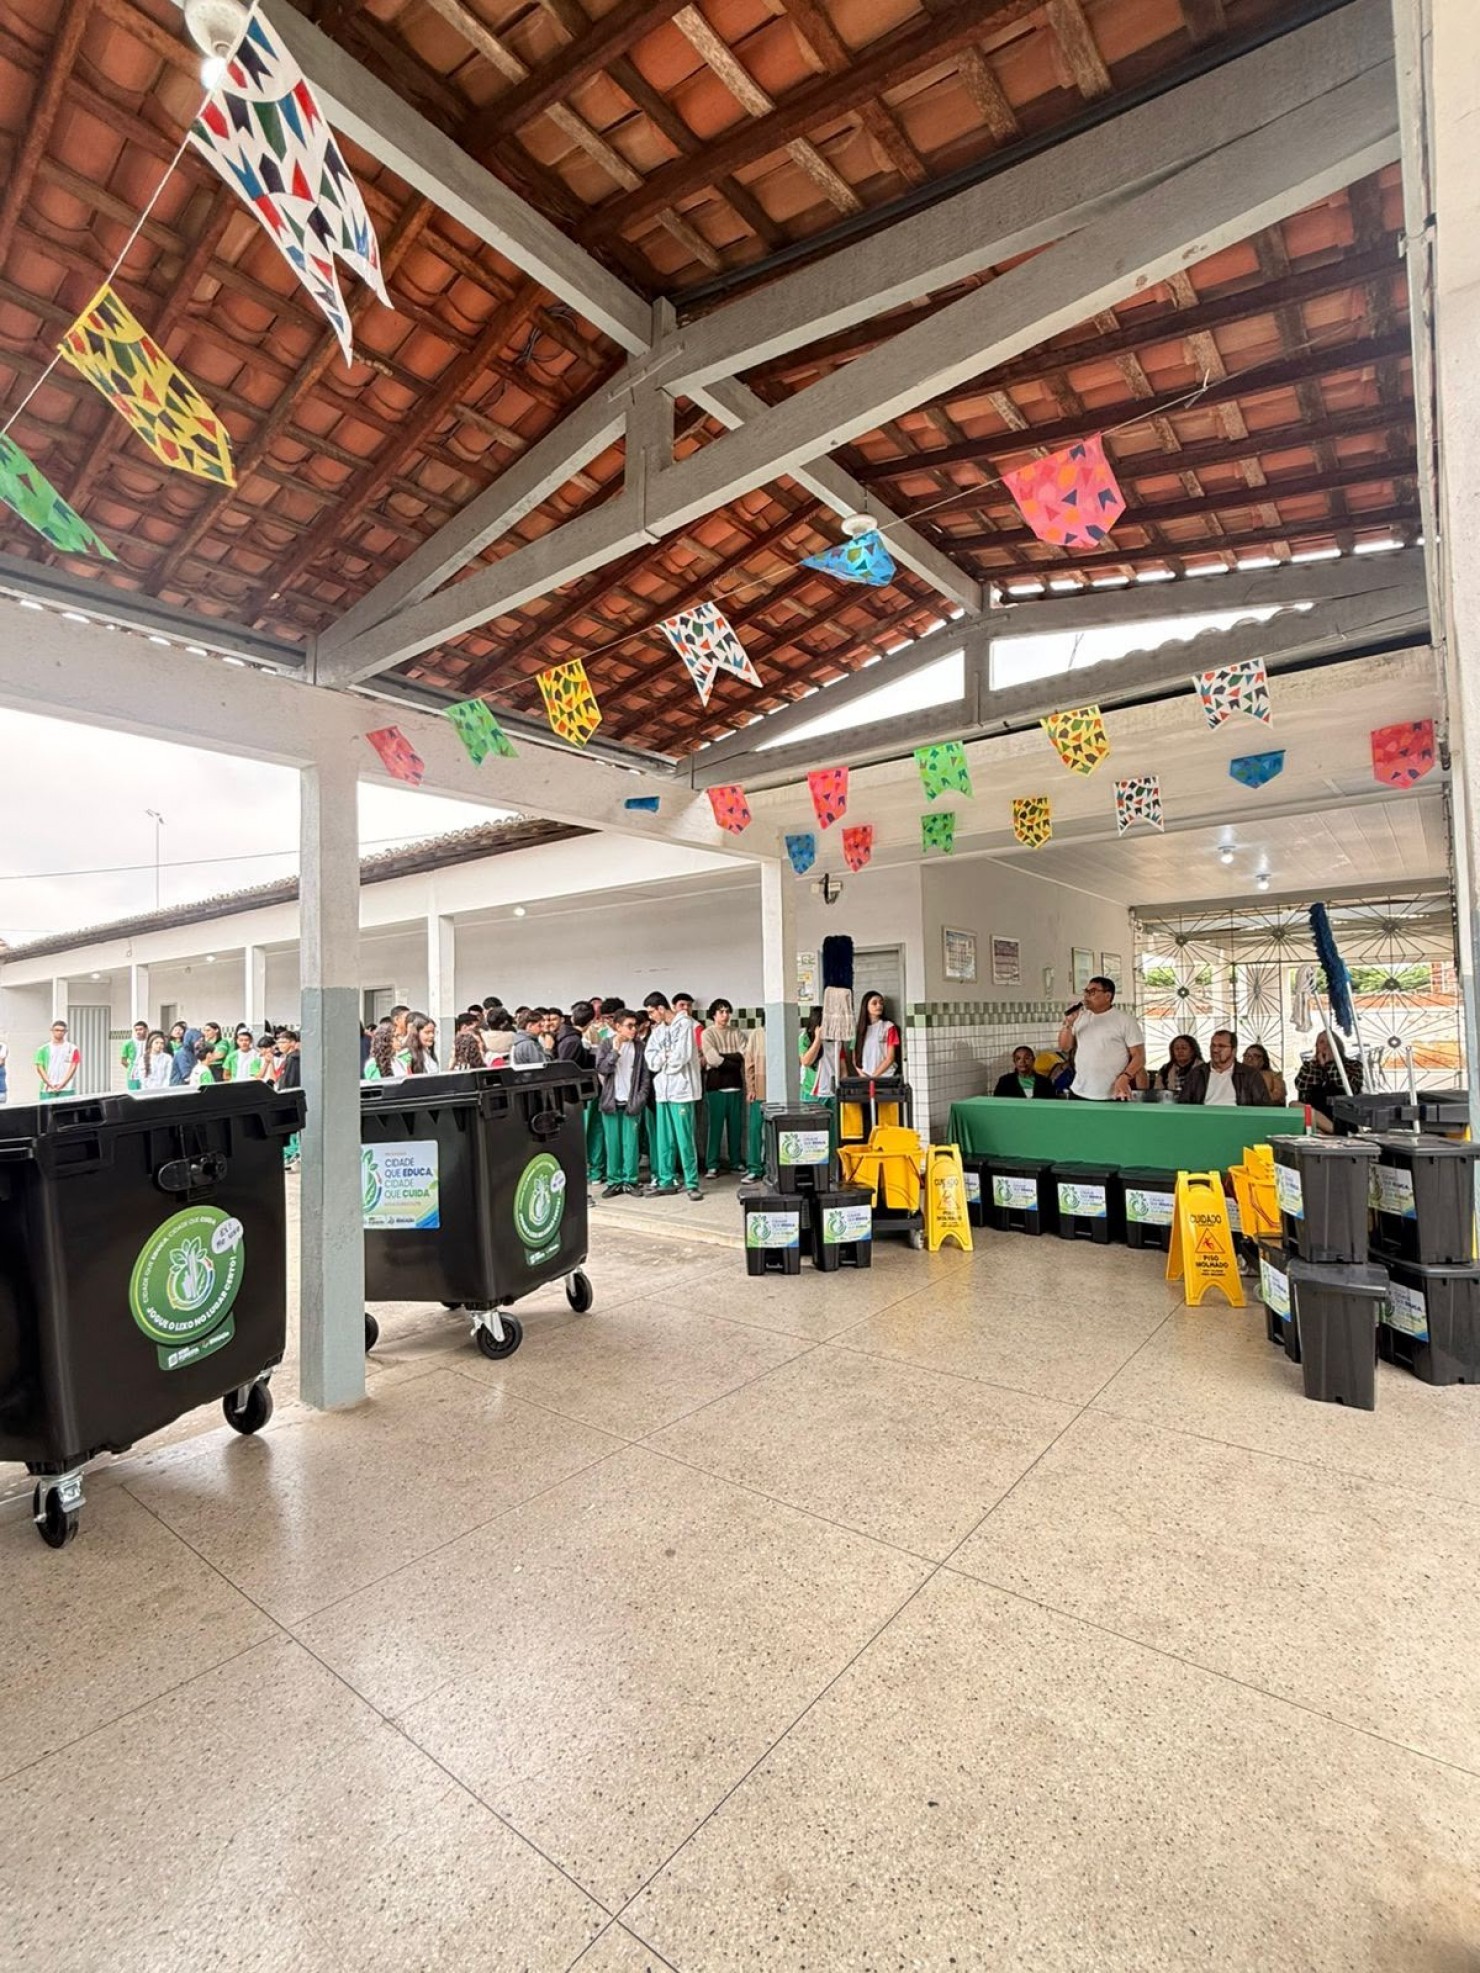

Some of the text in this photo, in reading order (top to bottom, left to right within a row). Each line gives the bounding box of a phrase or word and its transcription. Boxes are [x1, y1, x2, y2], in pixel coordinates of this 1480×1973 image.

[385, 1158, 414, 1167] CIDADE
[384, 1169, 401, 1178] QUE
[384, 1179, 413, 1188] CIDADE
[384, 1189, 430, 1198] QUE CUIDA
[147, 1256, 238, 1331] JOGUE O LIXO NO LUGAR CERTO!
